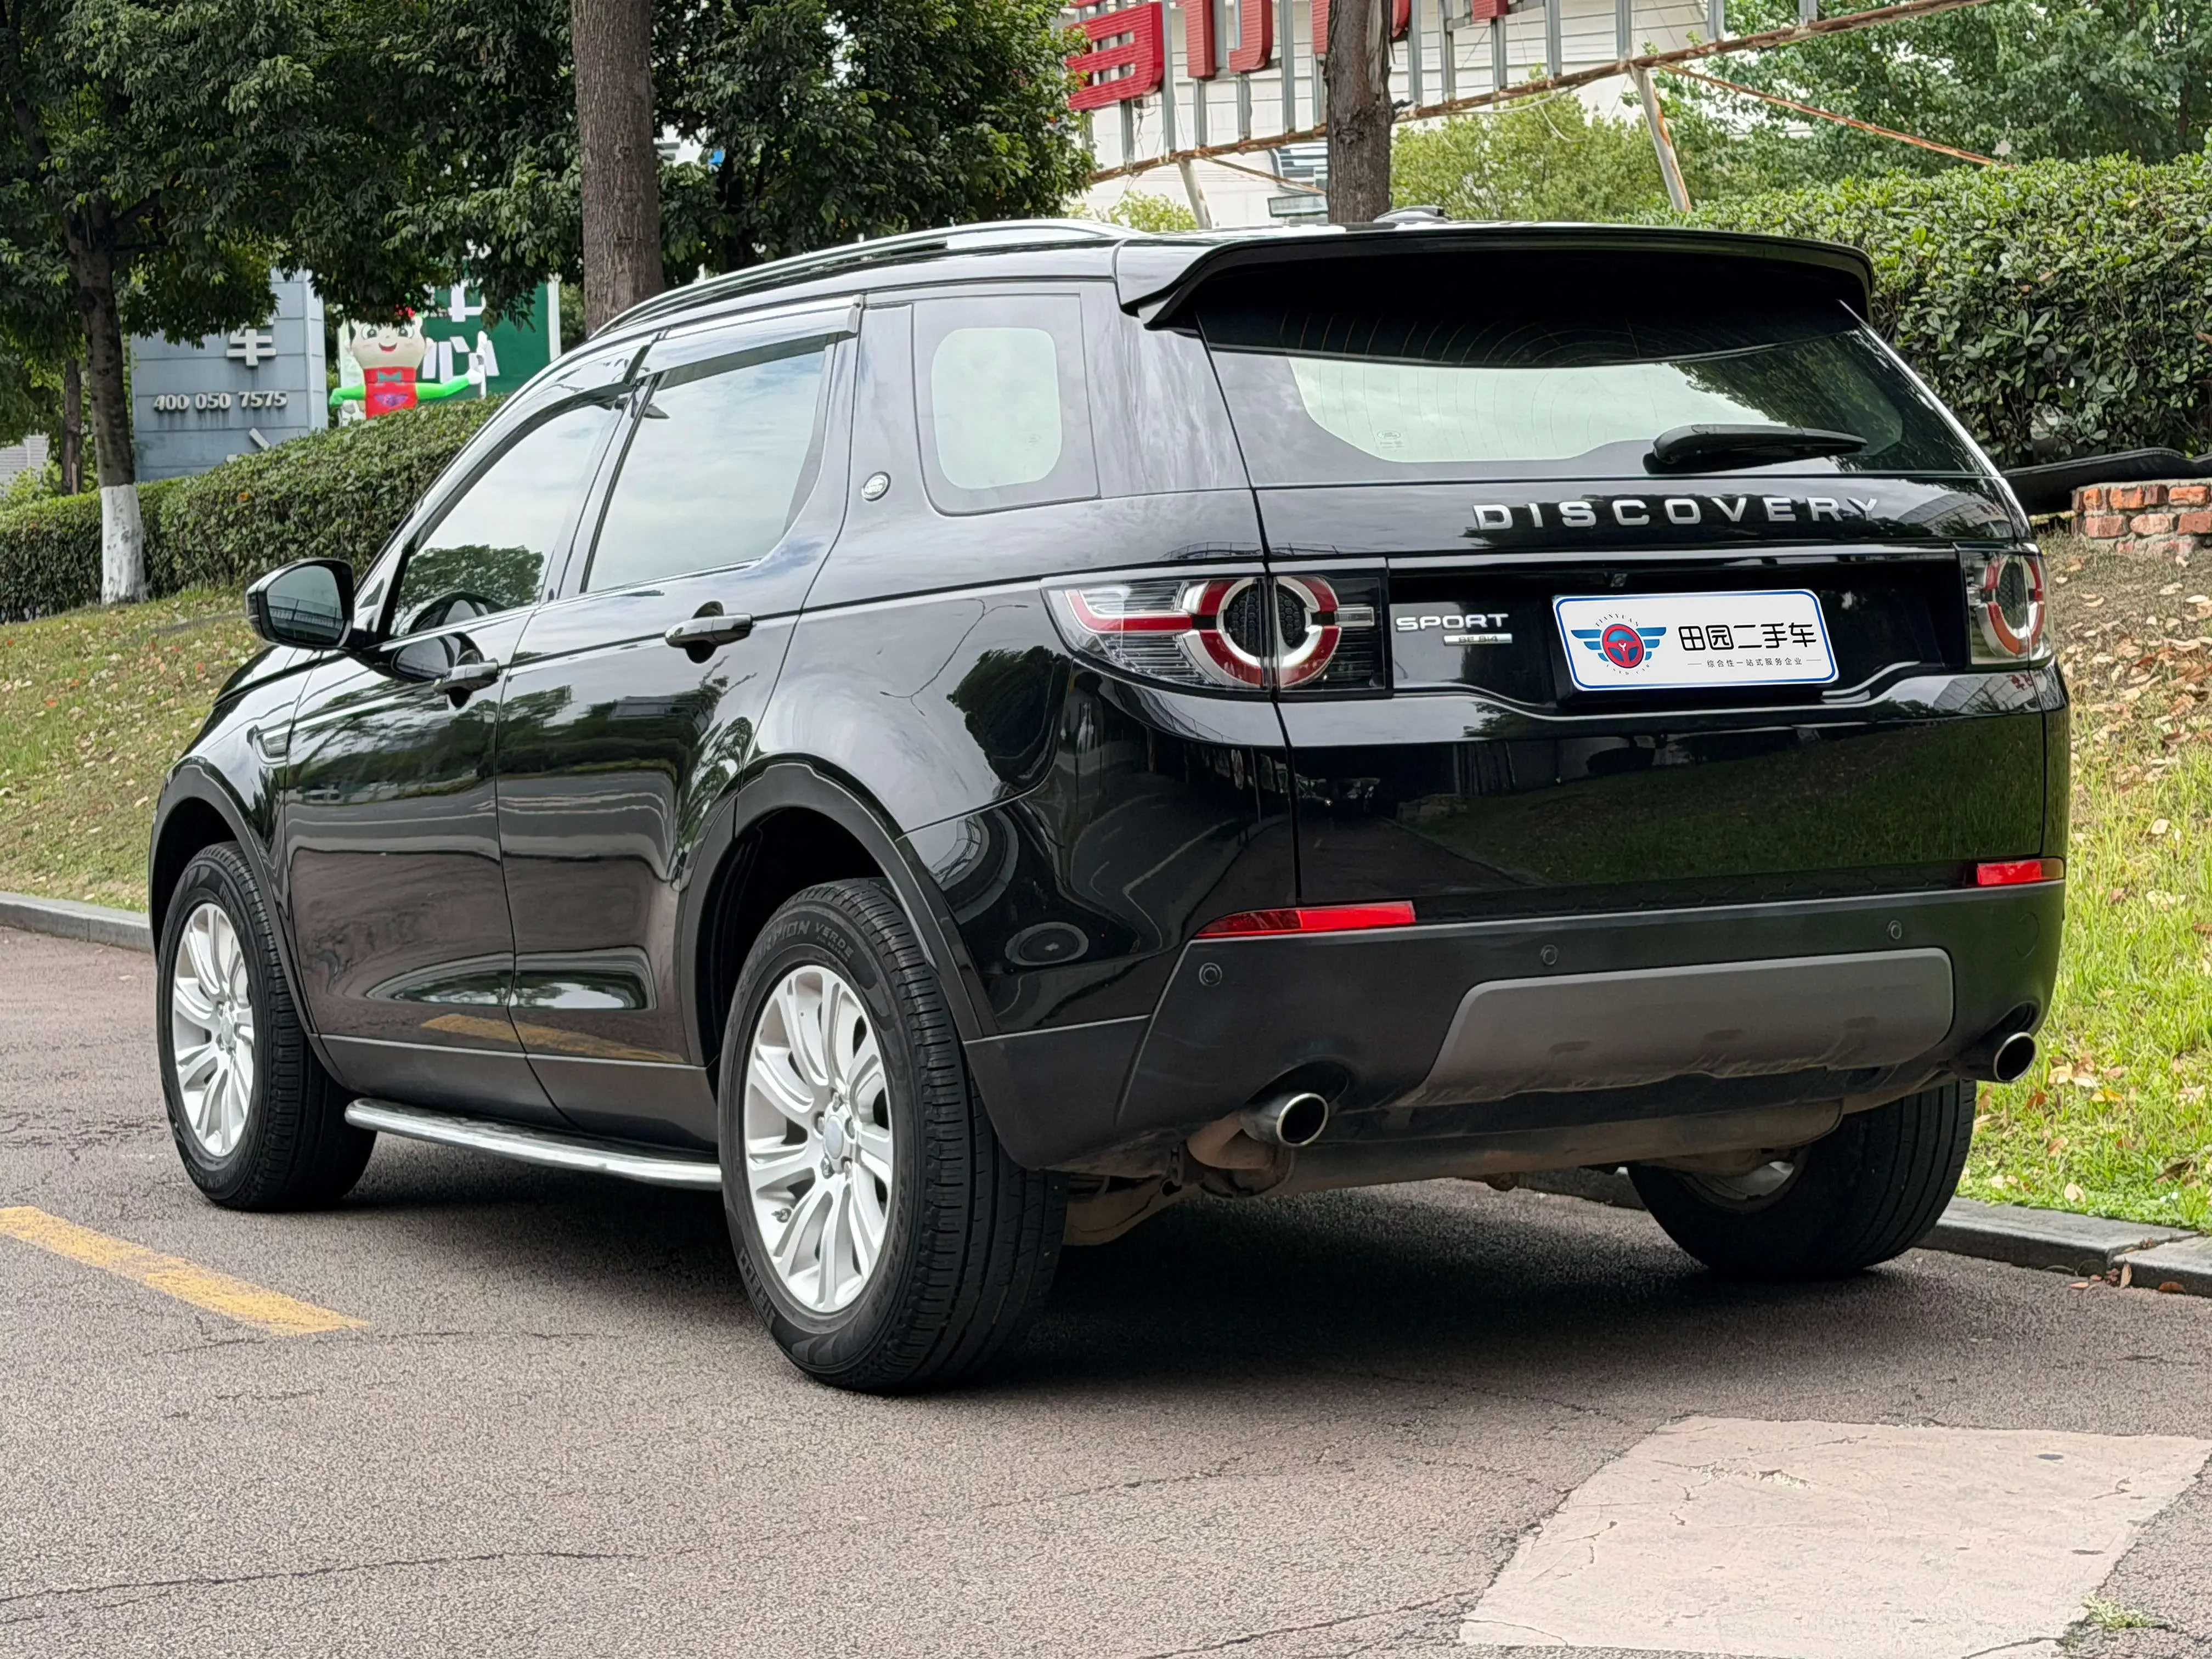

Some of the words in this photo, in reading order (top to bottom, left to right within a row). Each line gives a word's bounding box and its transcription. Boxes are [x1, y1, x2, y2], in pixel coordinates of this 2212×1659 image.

[153, 394, 190, 411] 400
[195, 392, 232, 410] 050
[238, 390, 288, 408] 7575
[1472, 495, 1878, 531] DISCOVERY
[1396, 613, 1509, 631] SPORT
[815, 922, 854, 957] VERDE
